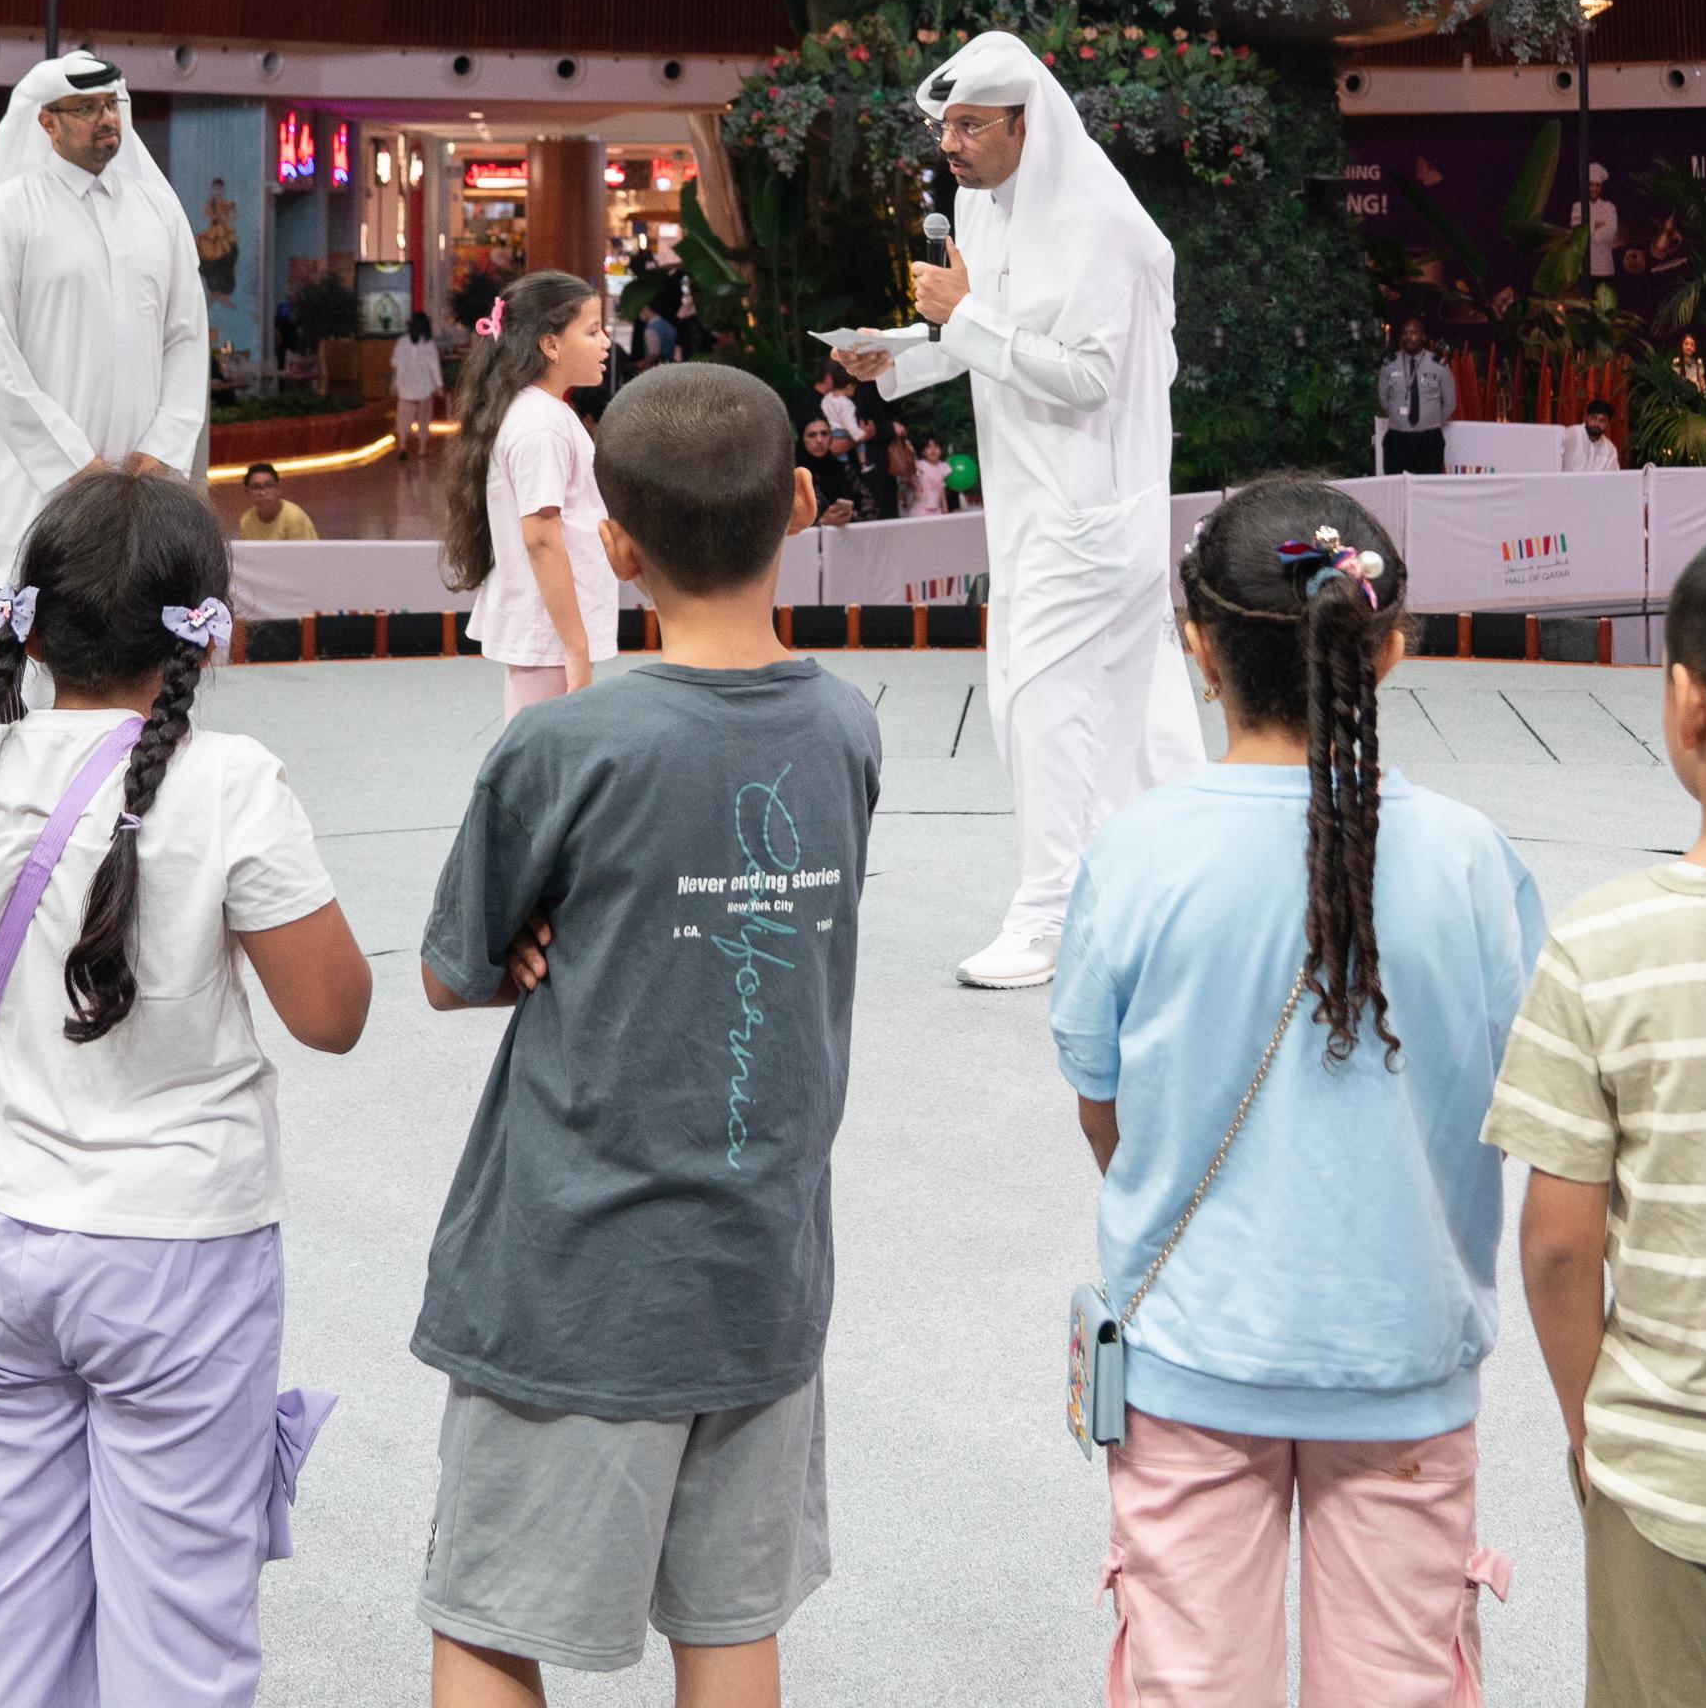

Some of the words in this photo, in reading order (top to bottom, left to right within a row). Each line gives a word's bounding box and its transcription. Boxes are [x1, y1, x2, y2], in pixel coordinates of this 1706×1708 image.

[677, 875, 727, 895] Never
[730, 871, 788, 894] ending
[791, 867, 841, 890] stories
[727, 901, 748, 914] New
[750, 900, 771, 913] York
[773, 899, 794, 913] City
